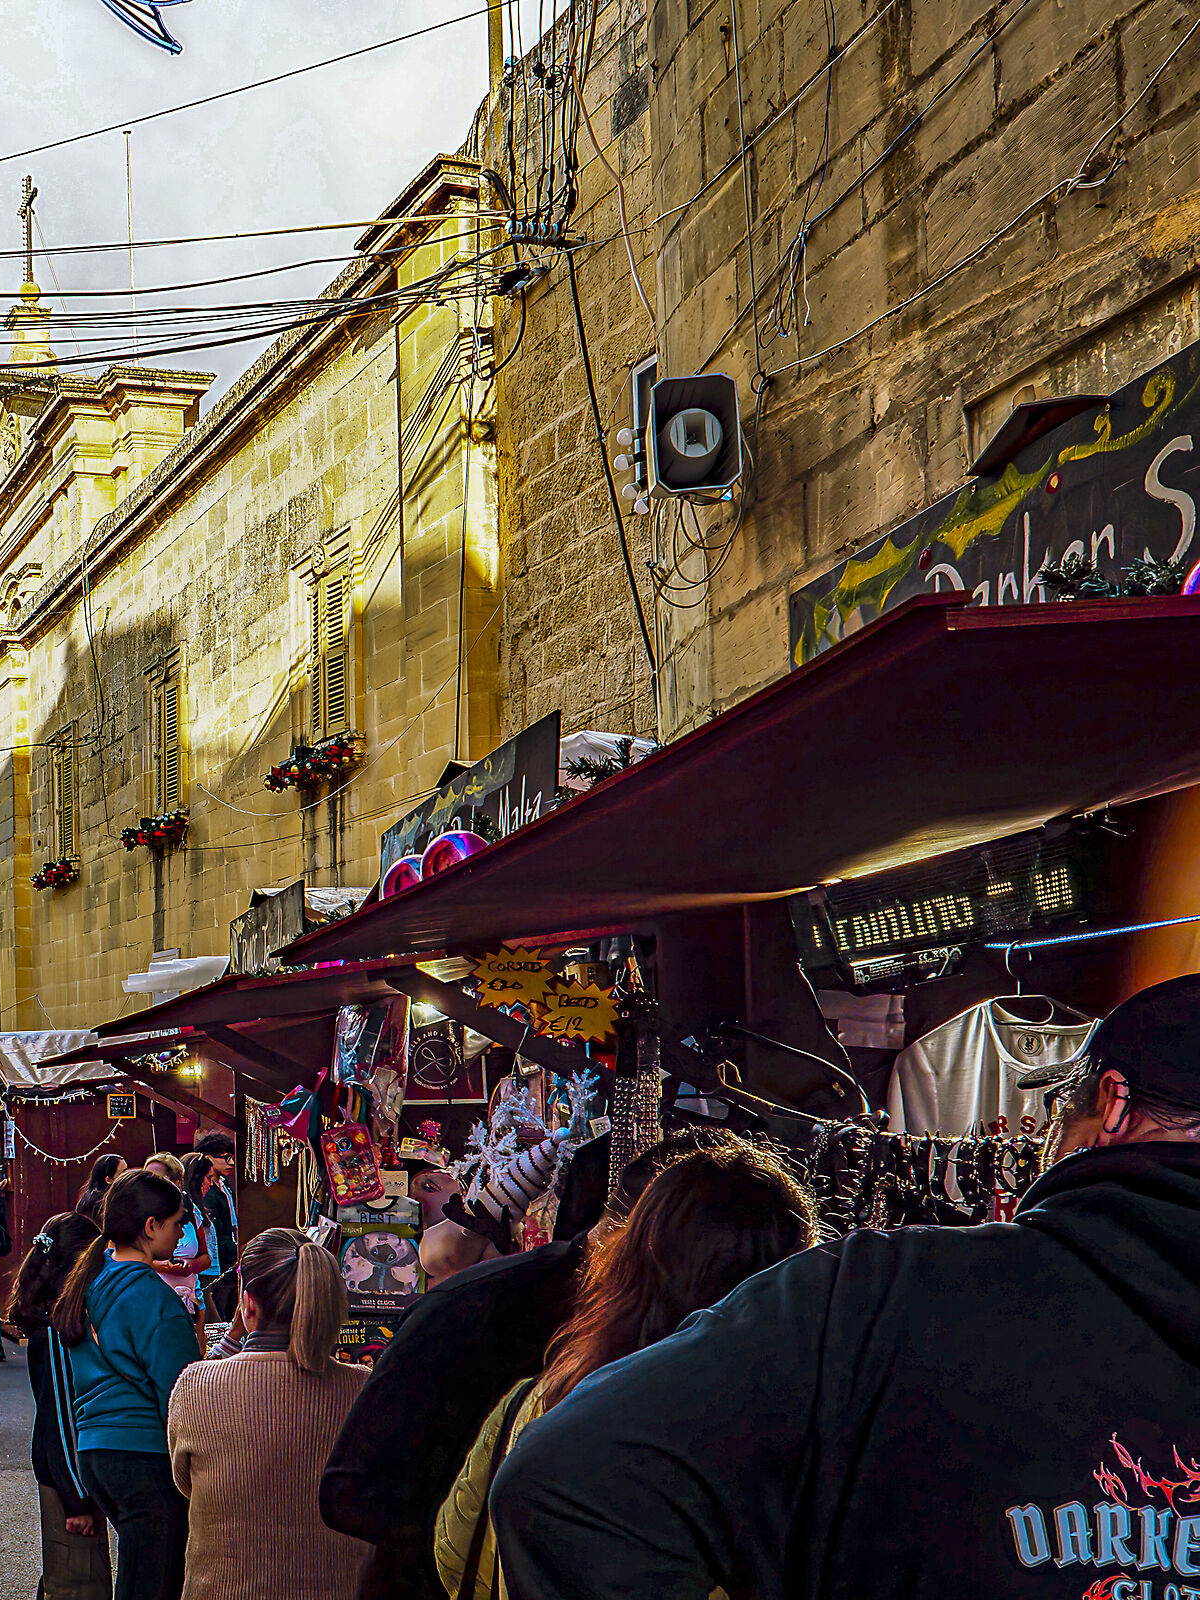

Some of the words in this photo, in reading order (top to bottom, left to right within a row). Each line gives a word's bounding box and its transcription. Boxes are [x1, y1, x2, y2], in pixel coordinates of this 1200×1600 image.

[498, 774, 543, 839] Malta
[549, 1016, 585, 1032] €12
[360, 1212, 395, 1225] BEST
